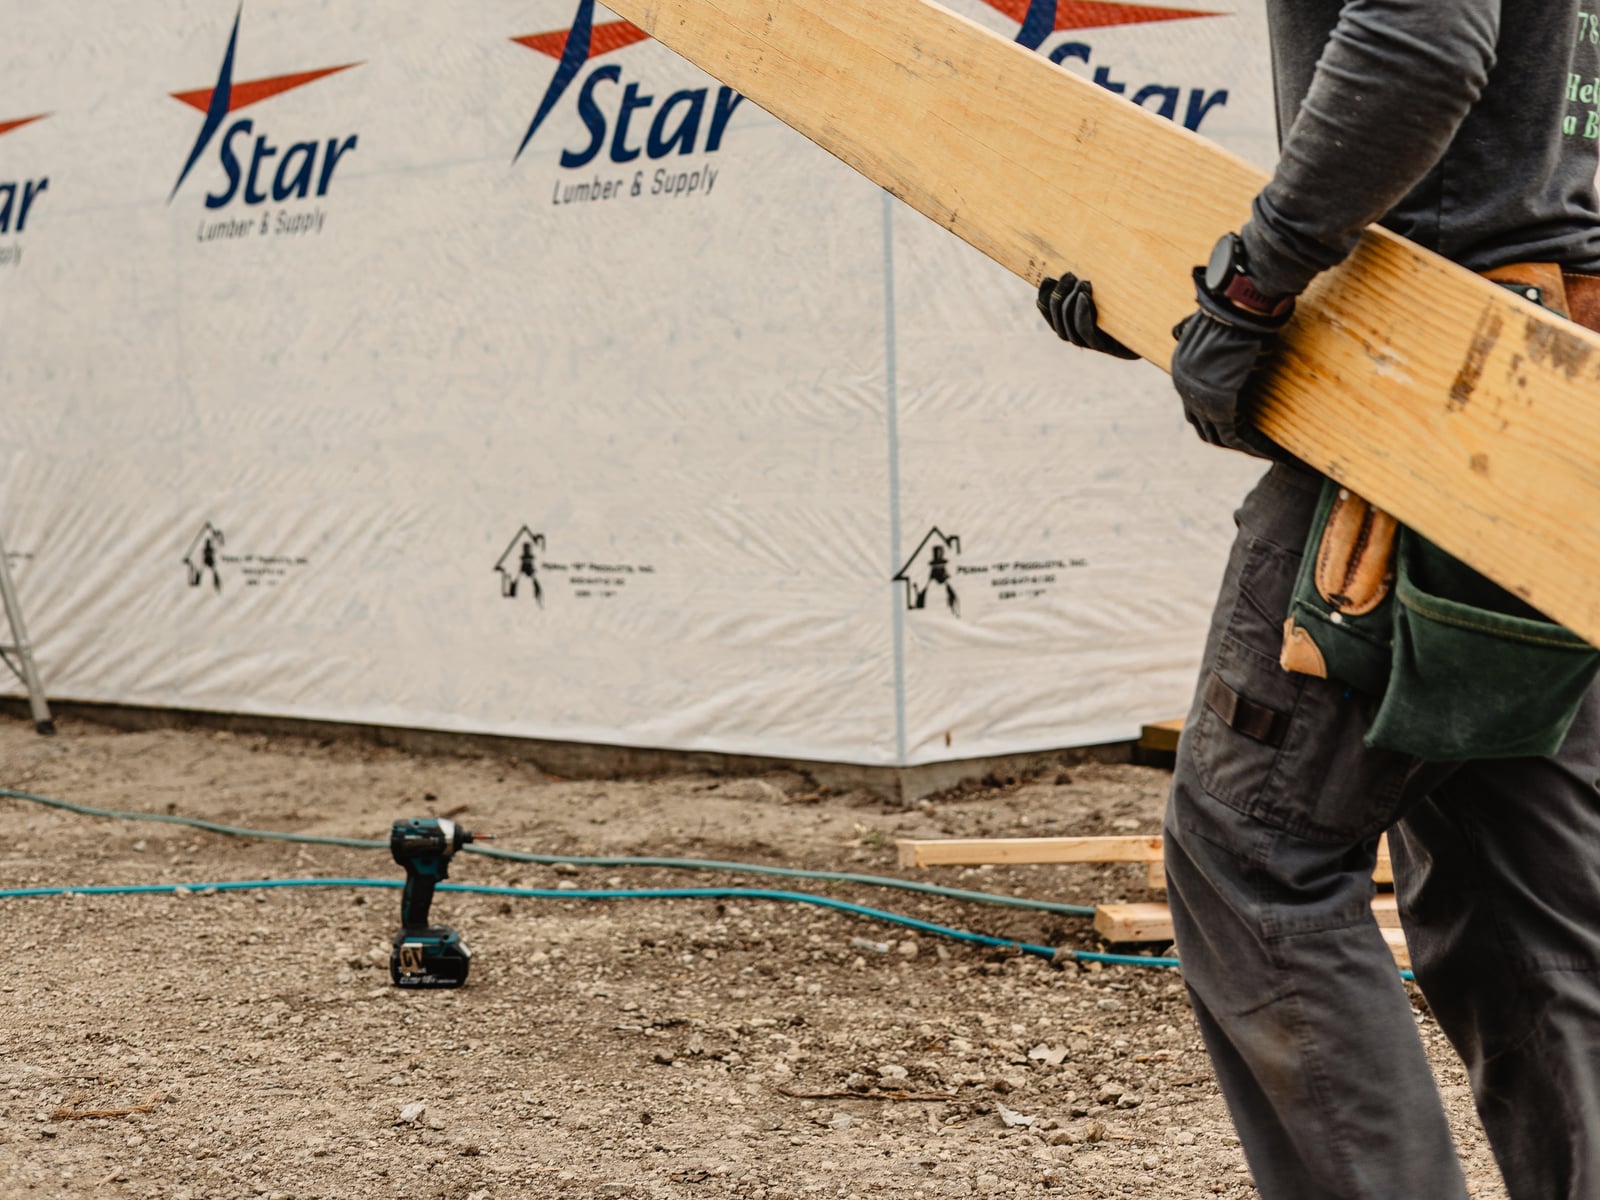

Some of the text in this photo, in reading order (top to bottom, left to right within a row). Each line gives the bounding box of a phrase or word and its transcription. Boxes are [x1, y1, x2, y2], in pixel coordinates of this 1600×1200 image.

[1565, 72, 1600, 112] Hel
[559, 64, 747, 169] Star
[205, 118, 358, 210] Star
[552, 164, 719, 206] Lumber & Supply
[197, 218, 254, 243] Lumber
[274, 208, 327, 237] Supply
